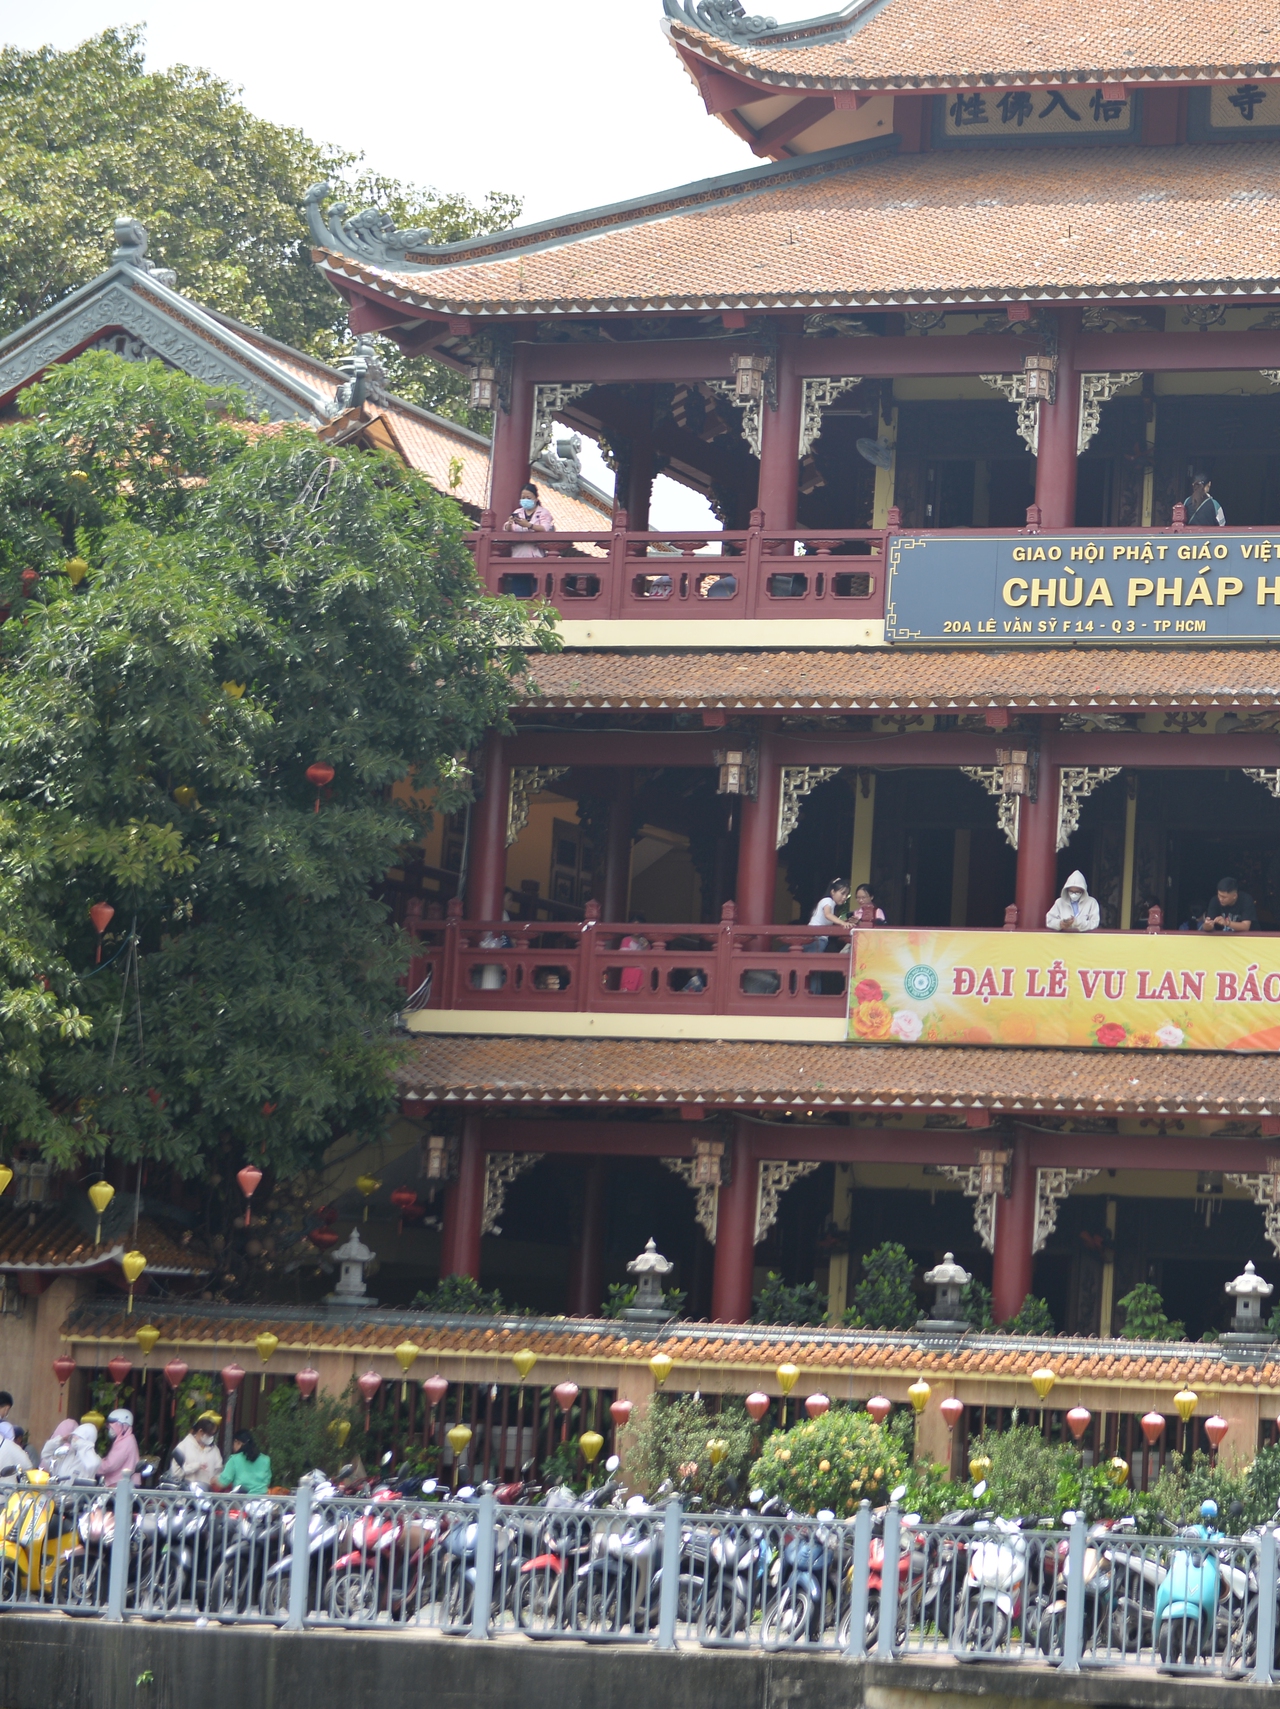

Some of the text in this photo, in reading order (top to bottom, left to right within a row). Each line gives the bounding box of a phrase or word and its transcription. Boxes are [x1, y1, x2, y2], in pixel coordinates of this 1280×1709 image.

[1012, 546, 1062, 562] GIAO
[1070, 542, 1105, 564] HỘI
[1113, 541, 1168, 564] PHẬT
[1177, 541, 1228, 560] GIÁO
[1002, 566, 1114, 607] CHÙA
[1127, 565, 1244, 607] PHÁP
[943, 620, 972, 633] 20A
[977, 618, 997, 633] LÊ
[1003, 616, 1033, 633] VĂN
[1037, 617, 1058, 633] SỸ
[1112, 620, 1122, 633] Q
[1125, 620, 1135, 632] 3
[1153, 620, 1171, 632] TP
[1175, 619, 1207, 632] HCM
[952, 967, 1014, 1003] ĐẠI
[1025, 960, 1067, 998] LỄ
[1078, 970, 1126, 999] VU
[1136, 971, 1205, 1000] LAN
